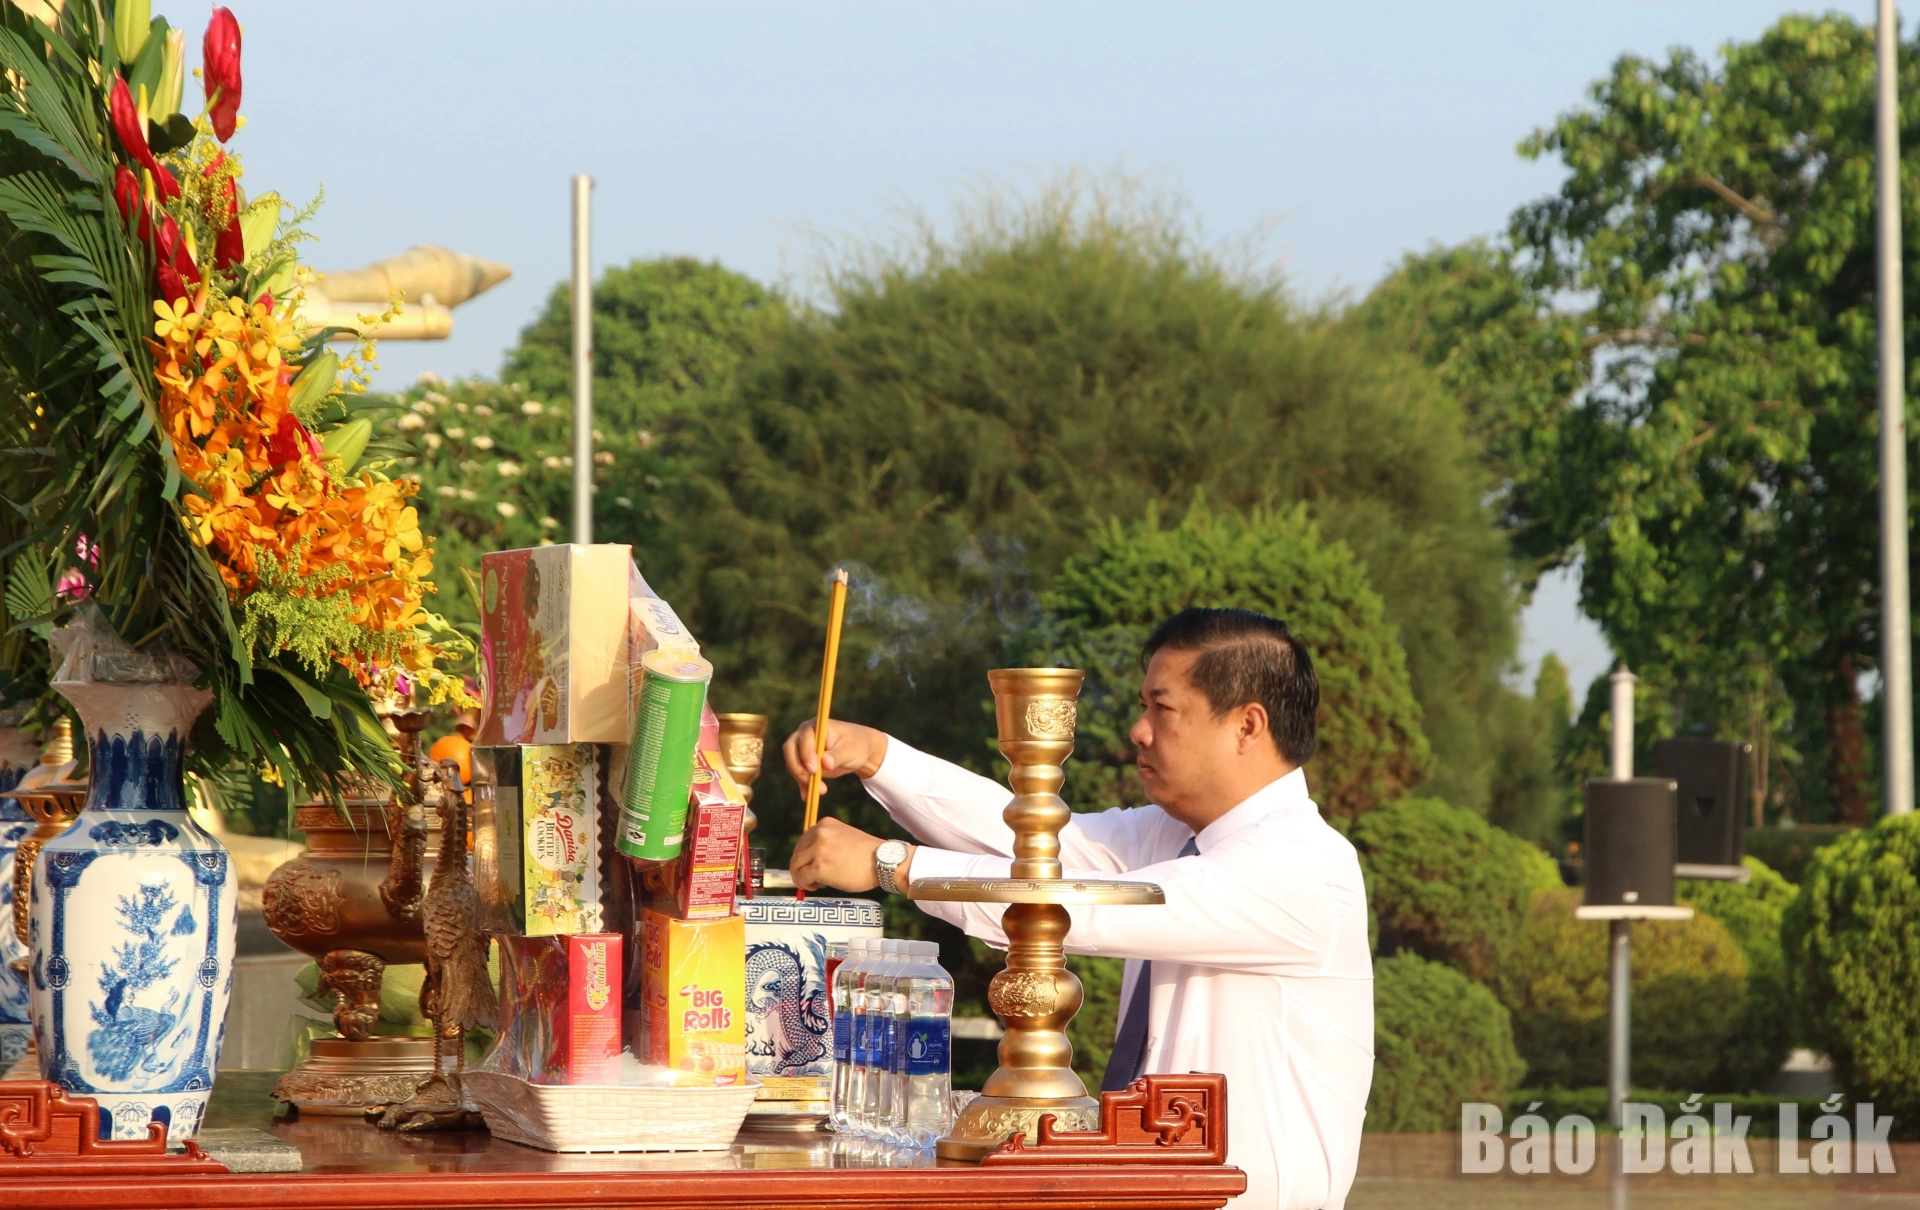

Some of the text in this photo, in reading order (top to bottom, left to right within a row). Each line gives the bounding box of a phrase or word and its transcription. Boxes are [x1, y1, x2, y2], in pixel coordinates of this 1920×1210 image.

[537, 820, 546, 860] COOKIES
[546, 822, 554, 857] BUTTER
[555, 811, 579, 865] Danisa
[693, 990, 723, 1007] BIG
